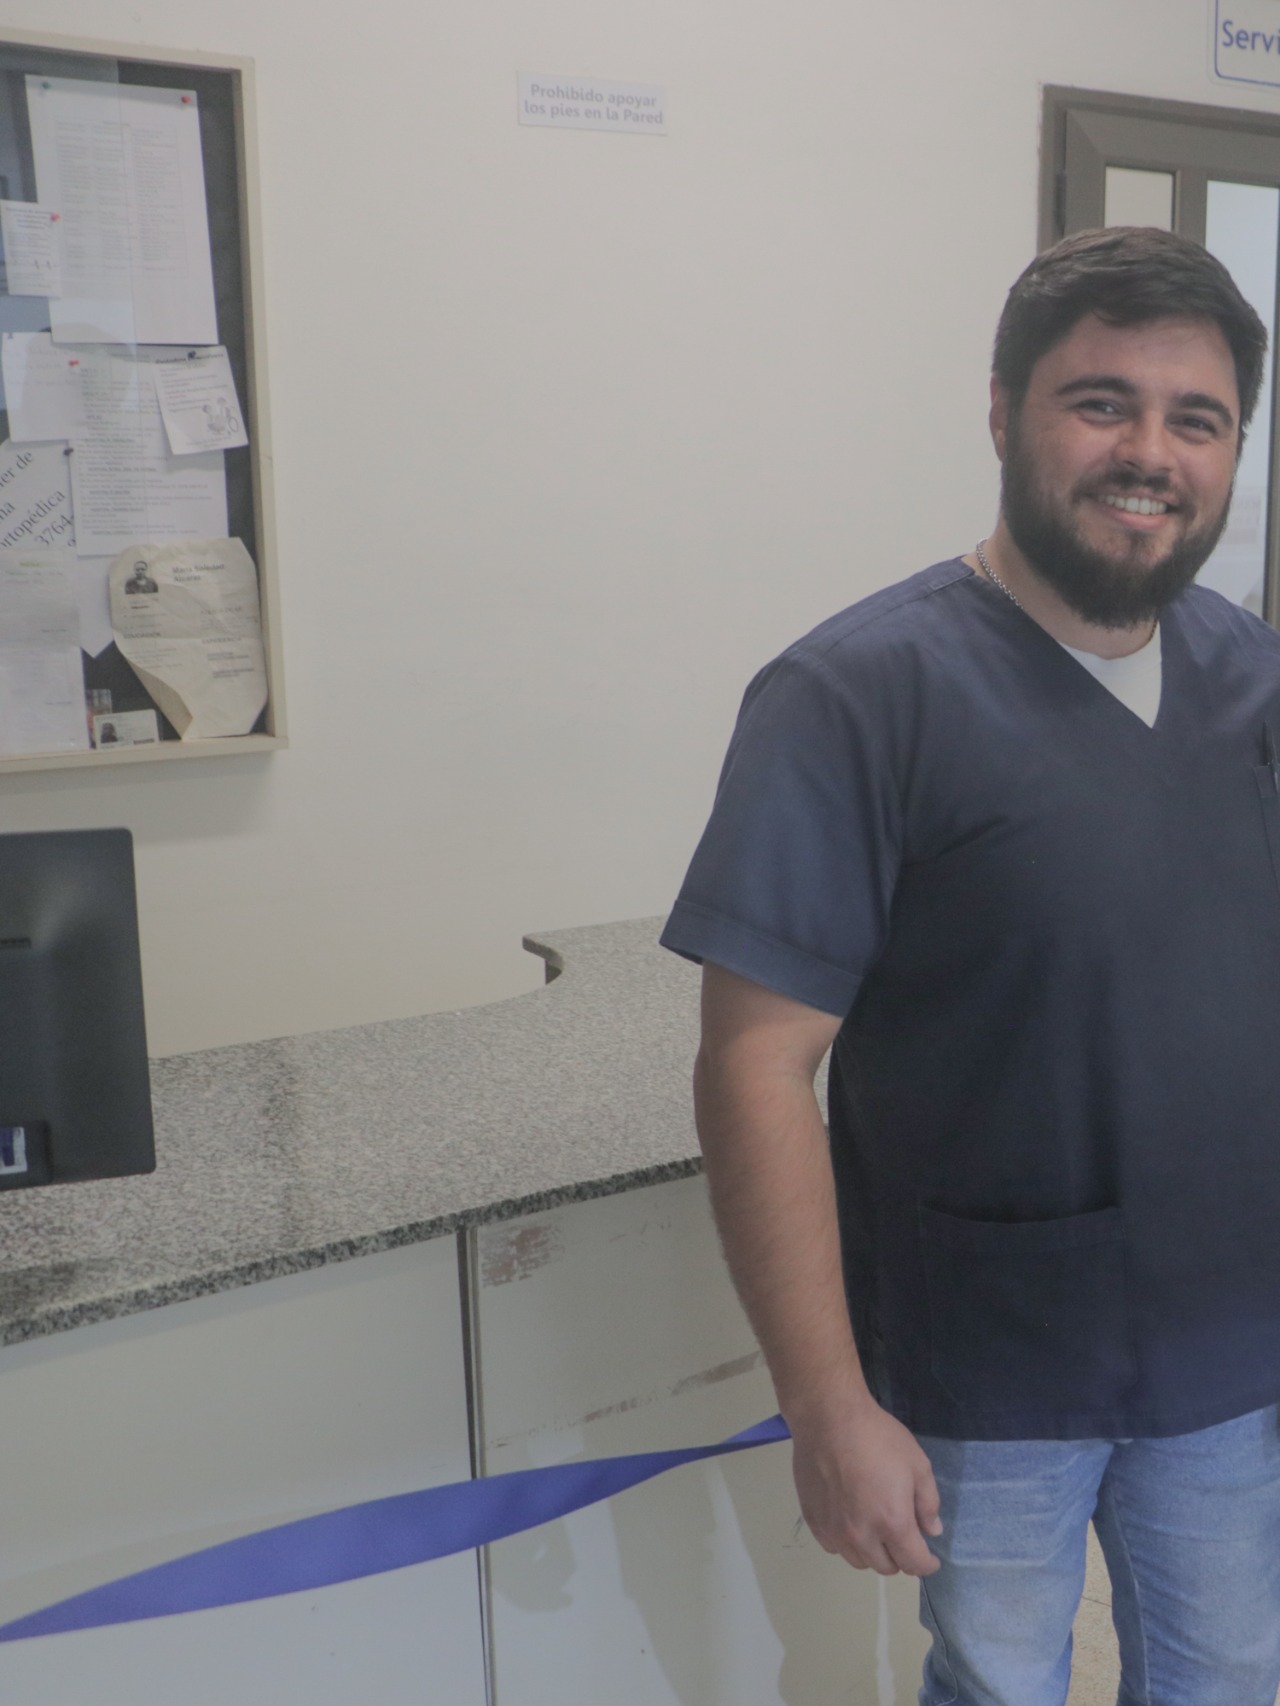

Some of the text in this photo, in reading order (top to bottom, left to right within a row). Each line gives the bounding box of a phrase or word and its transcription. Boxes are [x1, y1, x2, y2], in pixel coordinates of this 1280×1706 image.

[530, 83, 657, 109] Prohibido apoyar
[524, 99, 664, 124] los pies en la Pared
[16, 451, 33, 470] de
